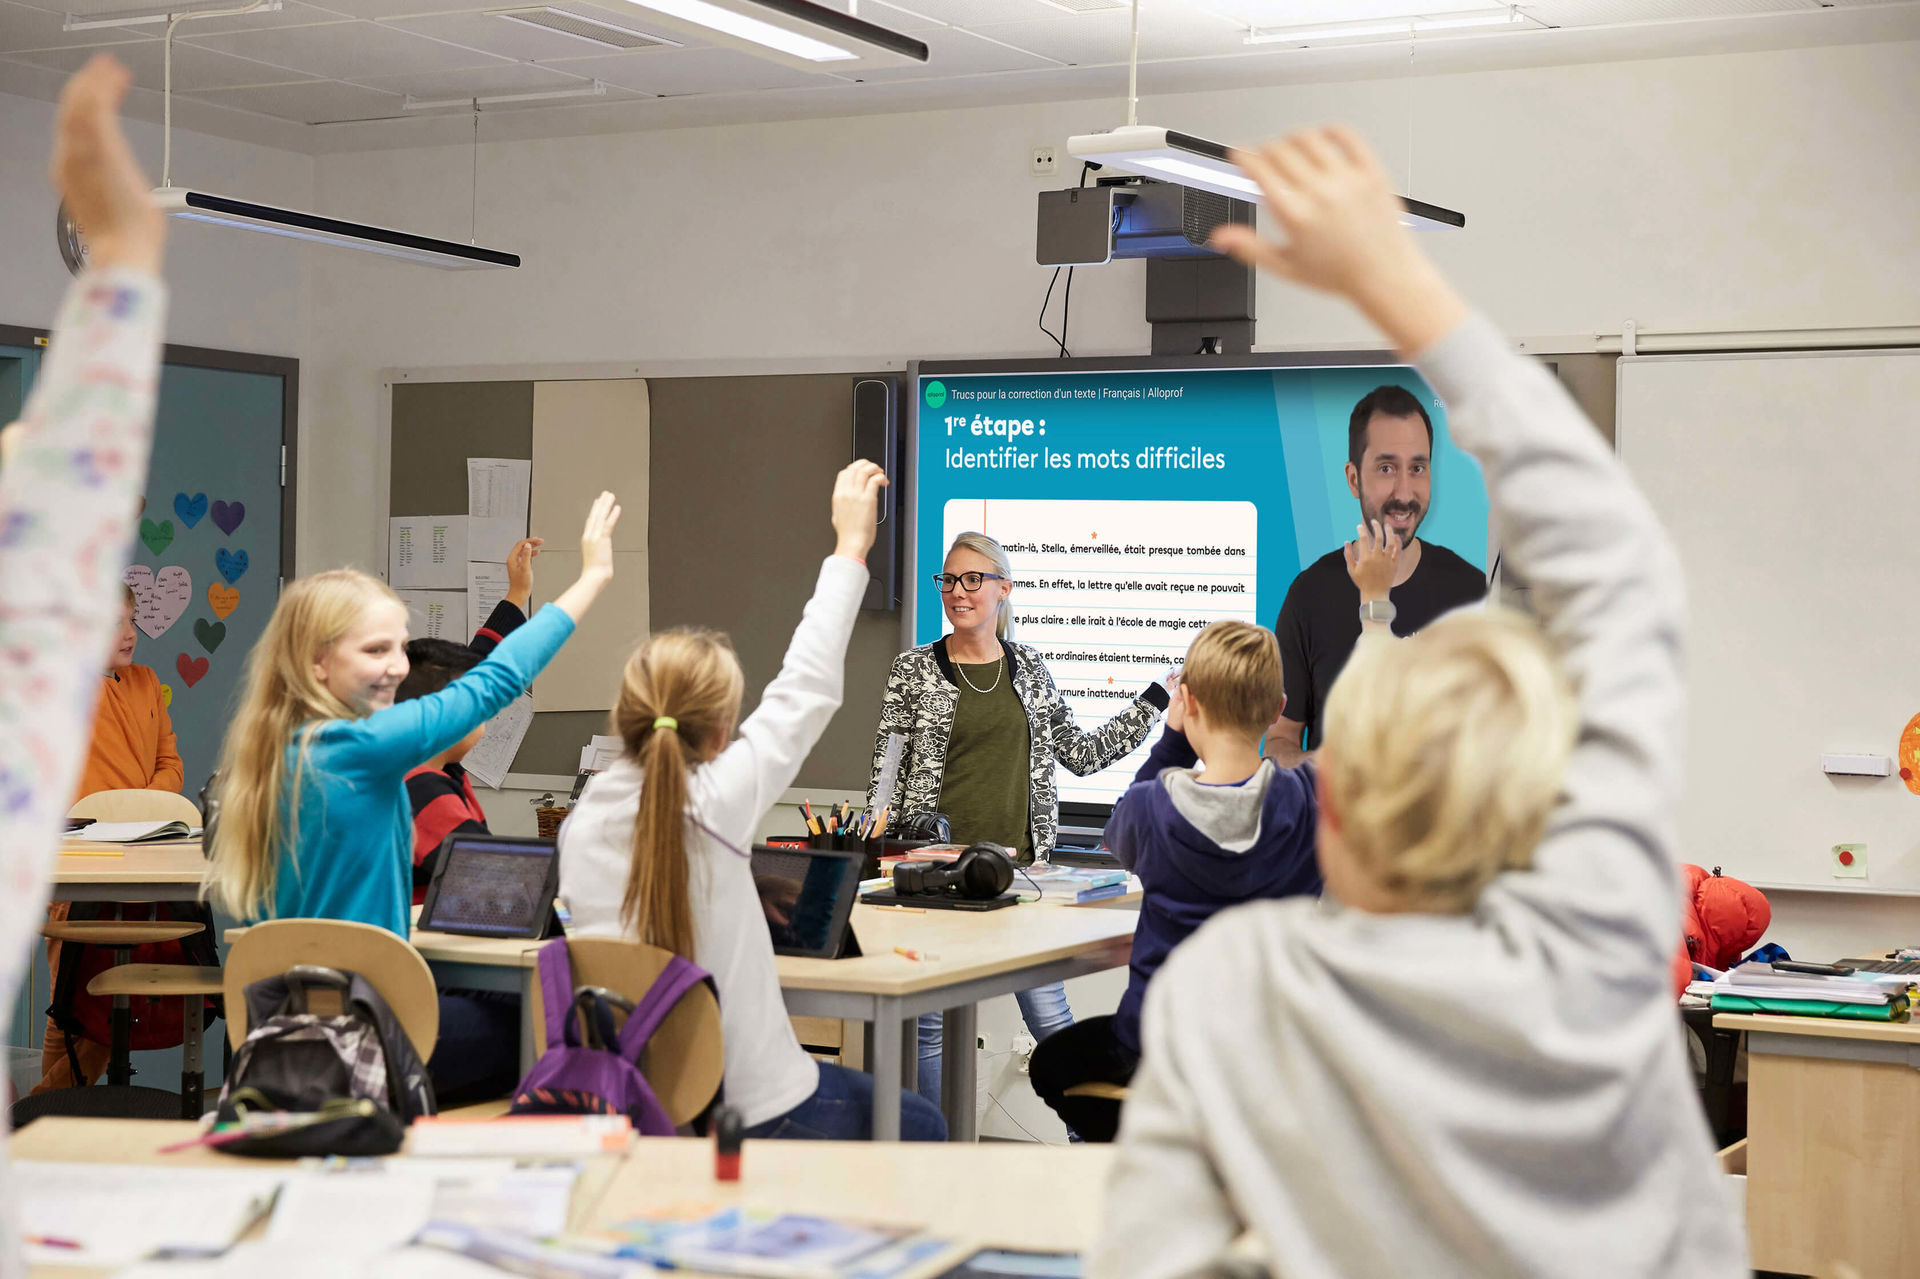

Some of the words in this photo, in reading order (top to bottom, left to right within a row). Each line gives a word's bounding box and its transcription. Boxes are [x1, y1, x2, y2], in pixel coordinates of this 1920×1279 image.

[951, 389, 975, 400] Trucs
[976, 391, 997, 402] pour
[998, 388, 1006, 400] la
[1008, 388, 1052, 400] correction
[1053, 388, 1072, 399] d'un
[1074, 389, 1096, 399] texte
[1103, 387, 1141, 401] Français
[1147, 386, 1184, 400] Alloprof
[944, 415, 967, 436] 1re
[970, 413, 1035, 443] étape
[945, 446, 1039, 469] Identifier
[1044, 446, 1072, 469] les
[1077, 449, 1130, 469] mots
[1135, 446, 1226, 469] difficiles
[1041, 543, 1068, 554] Stella,
[1070, 543, 1122, 556] émerveillée,
[1124, 544, 1146, 555] était
[1148, 547, 1184, 558] presque
[1186, 545, 1222, 556] tombée
[1223, 546, 1246, 556] dans
[1039, 579, 1050, 588] En
[1051, 579, 1075, 591] effet,
[1077, 579, 1086, 590] la
[1087, 579, 1113, 590] lettre
[1114, 580, 1143, 593] qu'elle
[1144, 581, 1168, 592] avait
[1170, 582, 1195, 594] reçue
[1197, 584, 1209, 592] ne
[1210, 582, 1246, 595] pouvait
[1021, 614, 1039, 626] plus
[1040, 614, 1064, 625] claire
[1070, 615, 1087, 626] elle
[1088, 615, 1106, 626] irait
[1107, 616, 1114, 626] à
[1116, 616, 1144, 627] l'école
[1145, 617, 1157, 627] de
[1158, 617, 1187, 631] magie
[1045, 651, 1055, 660] et
[1055, 650, 1098, 662] ordinaires
[1098, 652, 1131, 663] étaient
[1132, 653, 1173, 666] terminés,
